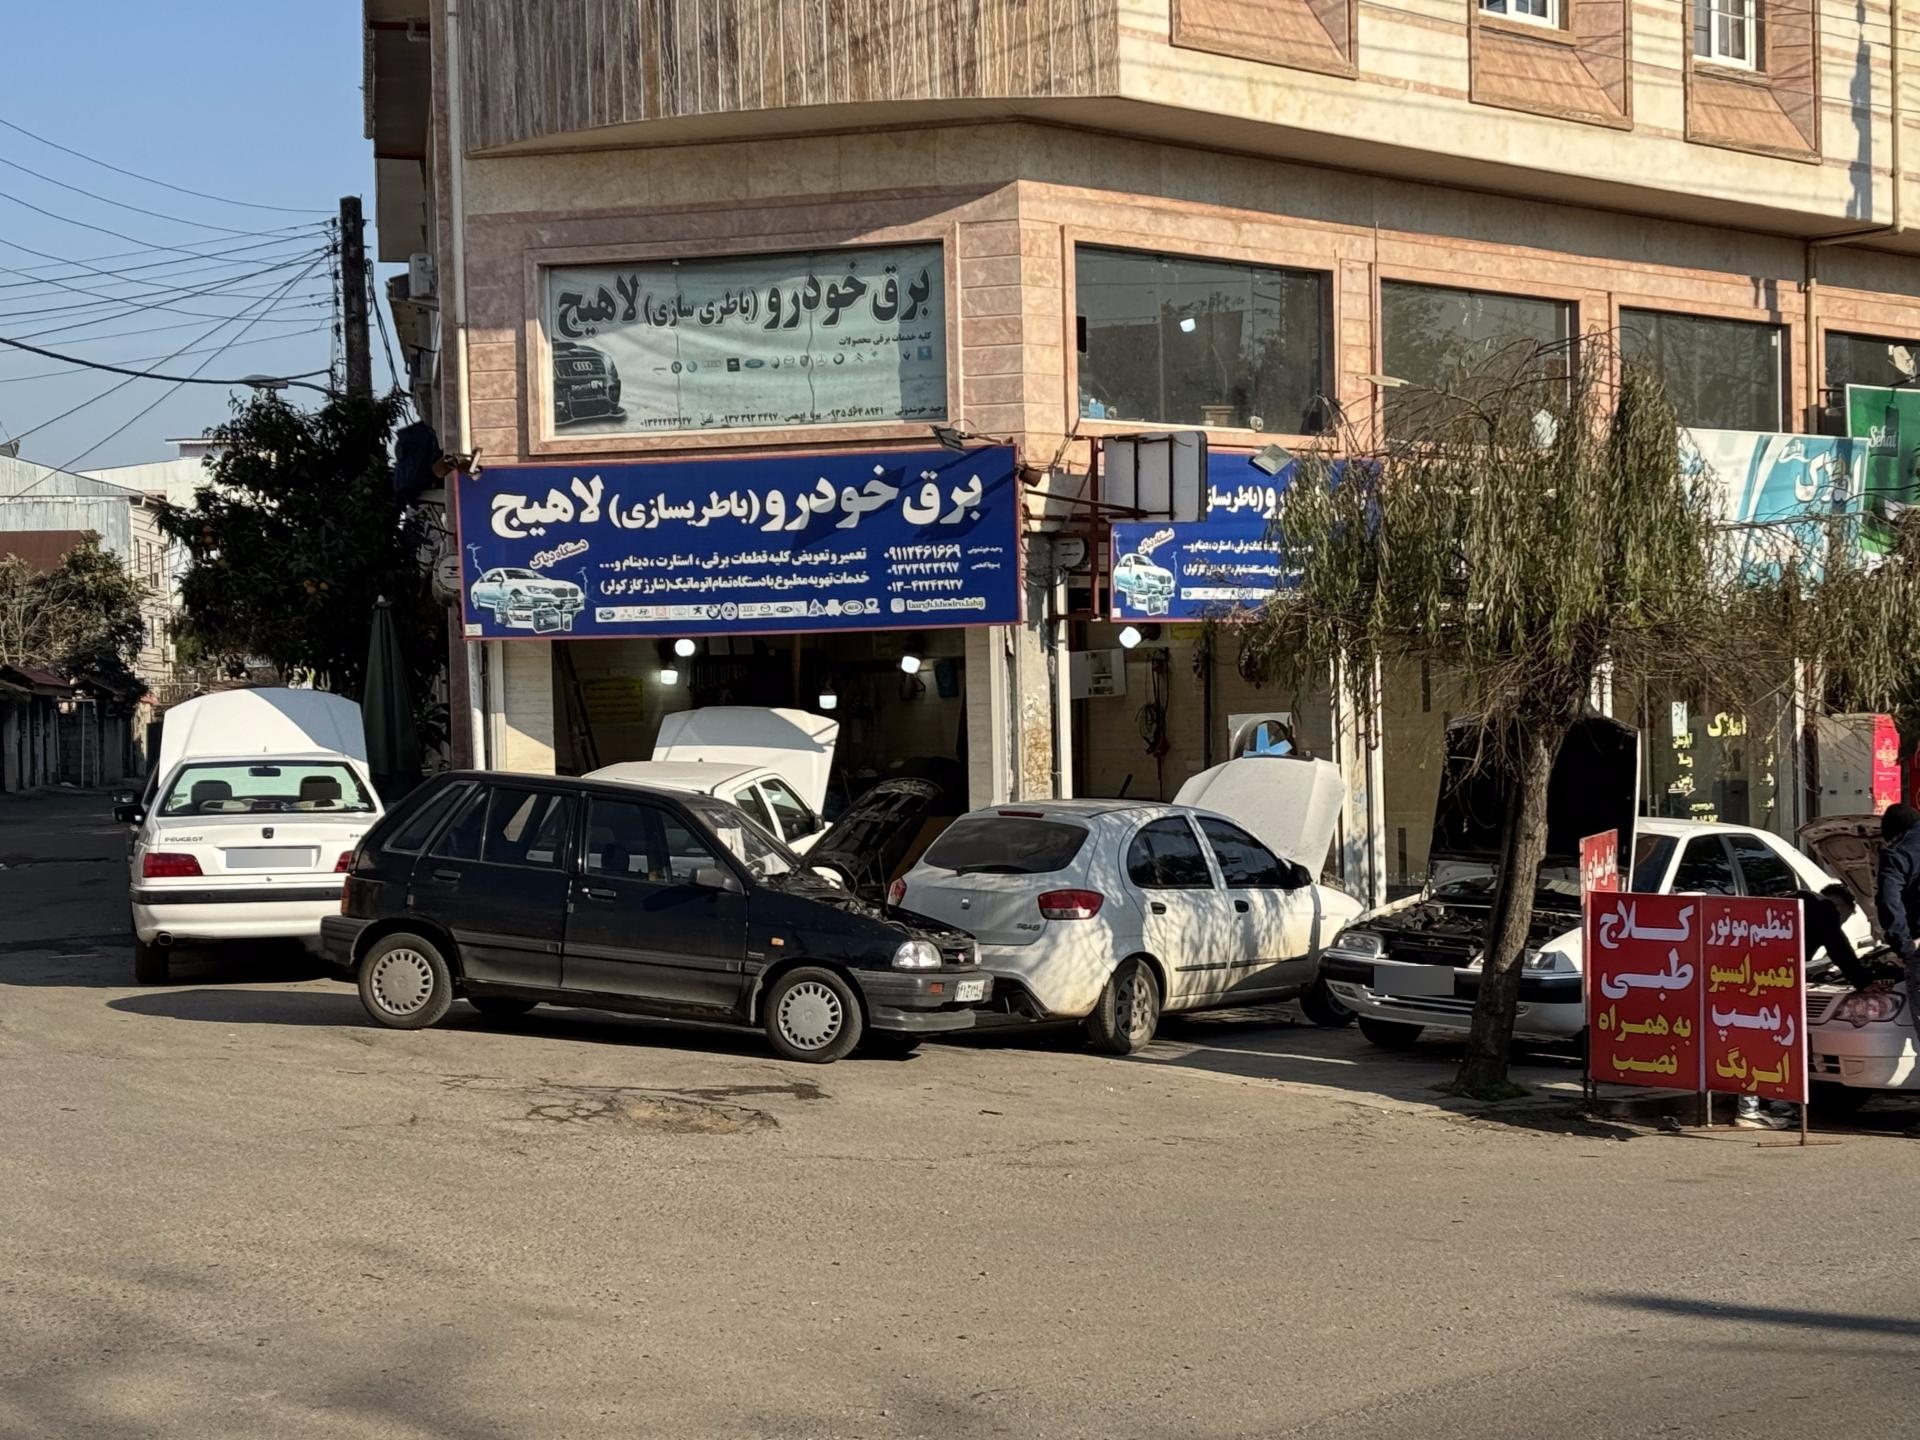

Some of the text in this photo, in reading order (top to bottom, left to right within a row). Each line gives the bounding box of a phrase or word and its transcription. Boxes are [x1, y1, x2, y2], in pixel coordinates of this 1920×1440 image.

[557, 260, 931, 339] برق خودرو (باطری سازی) لاهیج
[490, 474, 605, 539] لاهیج
[760, 463, 900, 532] خودرو
[902, 469, 983, 526] برق
[622, 555, 650, 571] دینام
[730, 550, 768, 565] قطعات
[769, 550, 791, 566] کلیه
[791, 548, 830, 566] تعویض
[830, 551, 838, 565] و
[837, 547, 868, 565] تعمیر
[627, 578, 643, 594] گاز
[712, 576, 733, 592] تمام
[732, 574, 766, 588] دستگاه
[765, 574, 775, 589] با
[774, 573, 808, 590] مطبوع
[807, 572, 834, 589] تهویه
[833, 570, 870, 584] خدمات
[1599, 900, 1695, 949] کلاج
[1706, 908, 1793, 948] تنظیم موتور
[1600, 947, 1695, 1001] طبی
[1708, 953, 1795, 997] تعمیر ایسیو
[1598, 1004, 1692, 1046] به همراه
[1711, 1003, 1796, 1046] ریمپ
[1612, 1044, 1679, 1078] نصب
[1715, 1046, 1790, 1092] ایربگ
